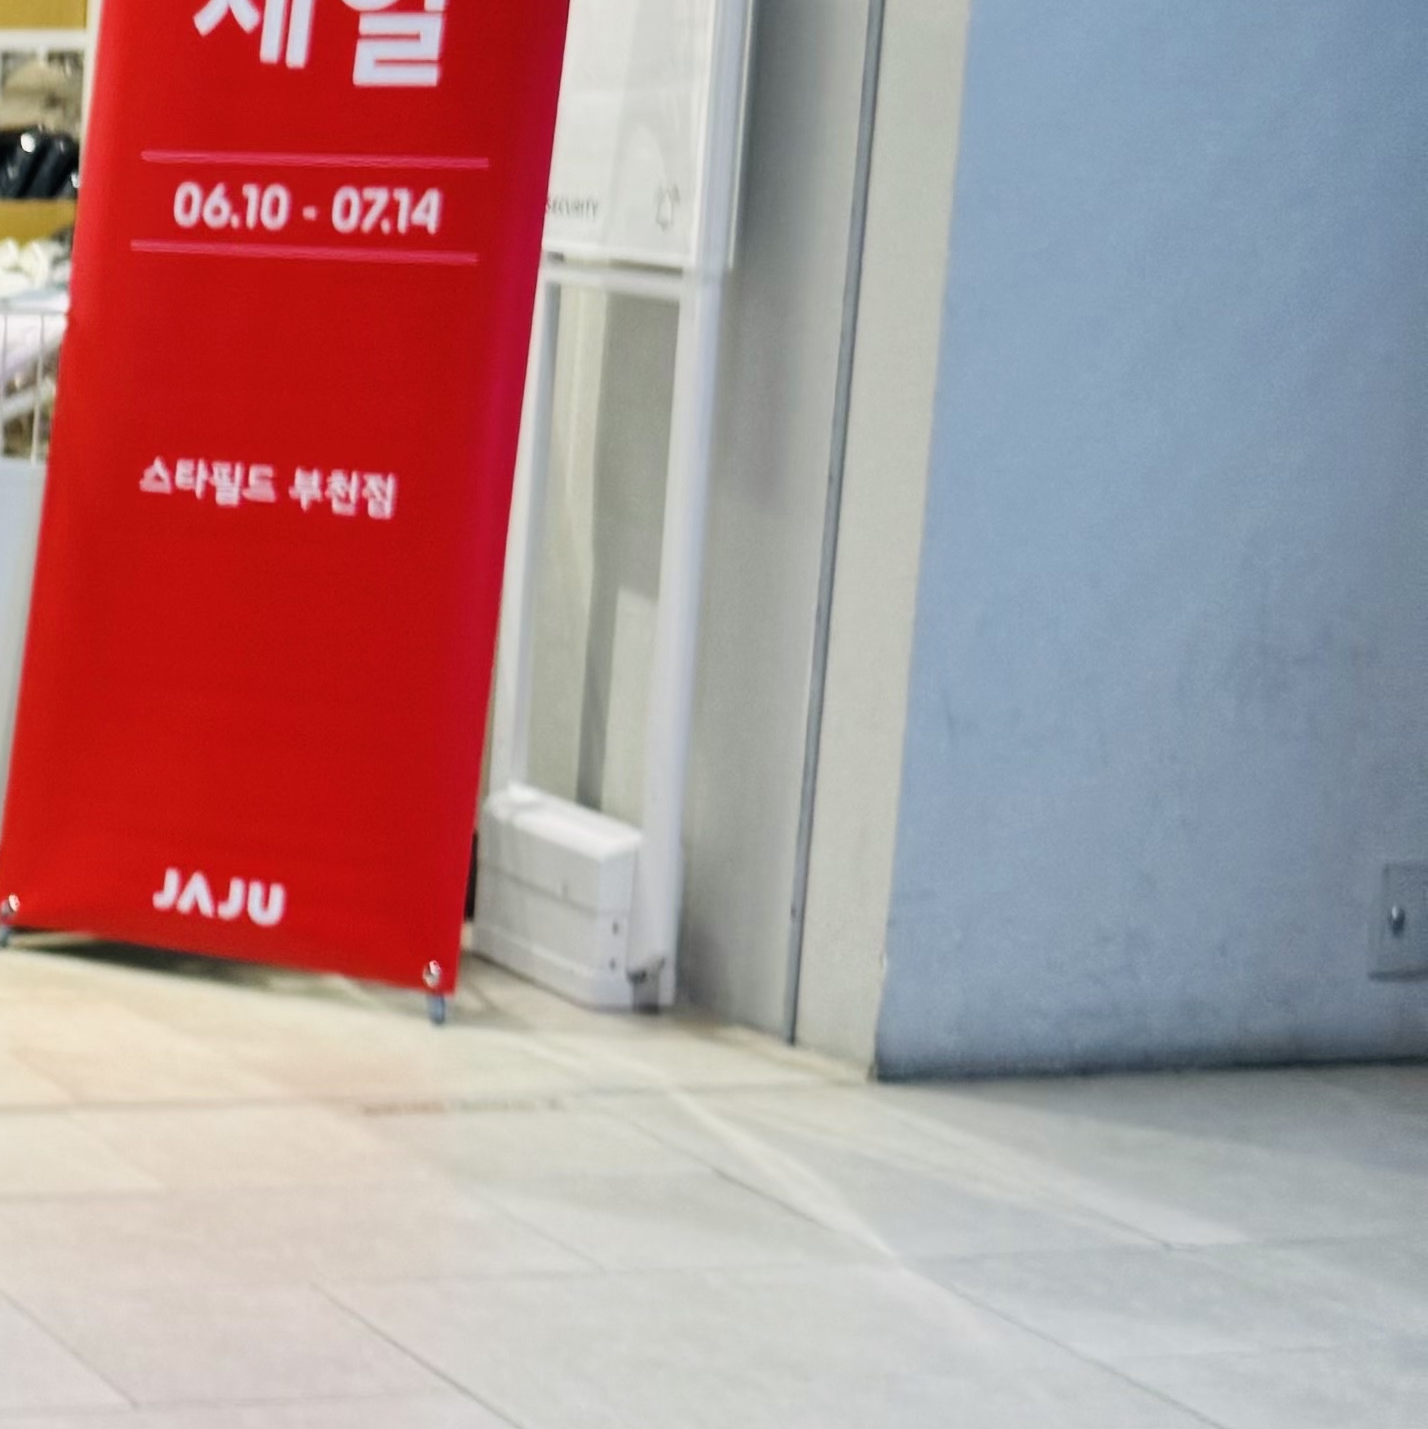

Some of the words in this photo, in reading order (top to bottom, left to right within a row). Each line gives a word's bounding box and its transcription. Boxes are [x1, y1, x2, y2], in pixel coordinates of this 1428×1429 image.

[173, 180, 290, 232] 06.10
[330, 185, 443, 236] 07.14
[139, 455, 278, 509] 스타필드
[288, 466, 398, 521] 부천점
[152, 866, 287, 929] JAJU
